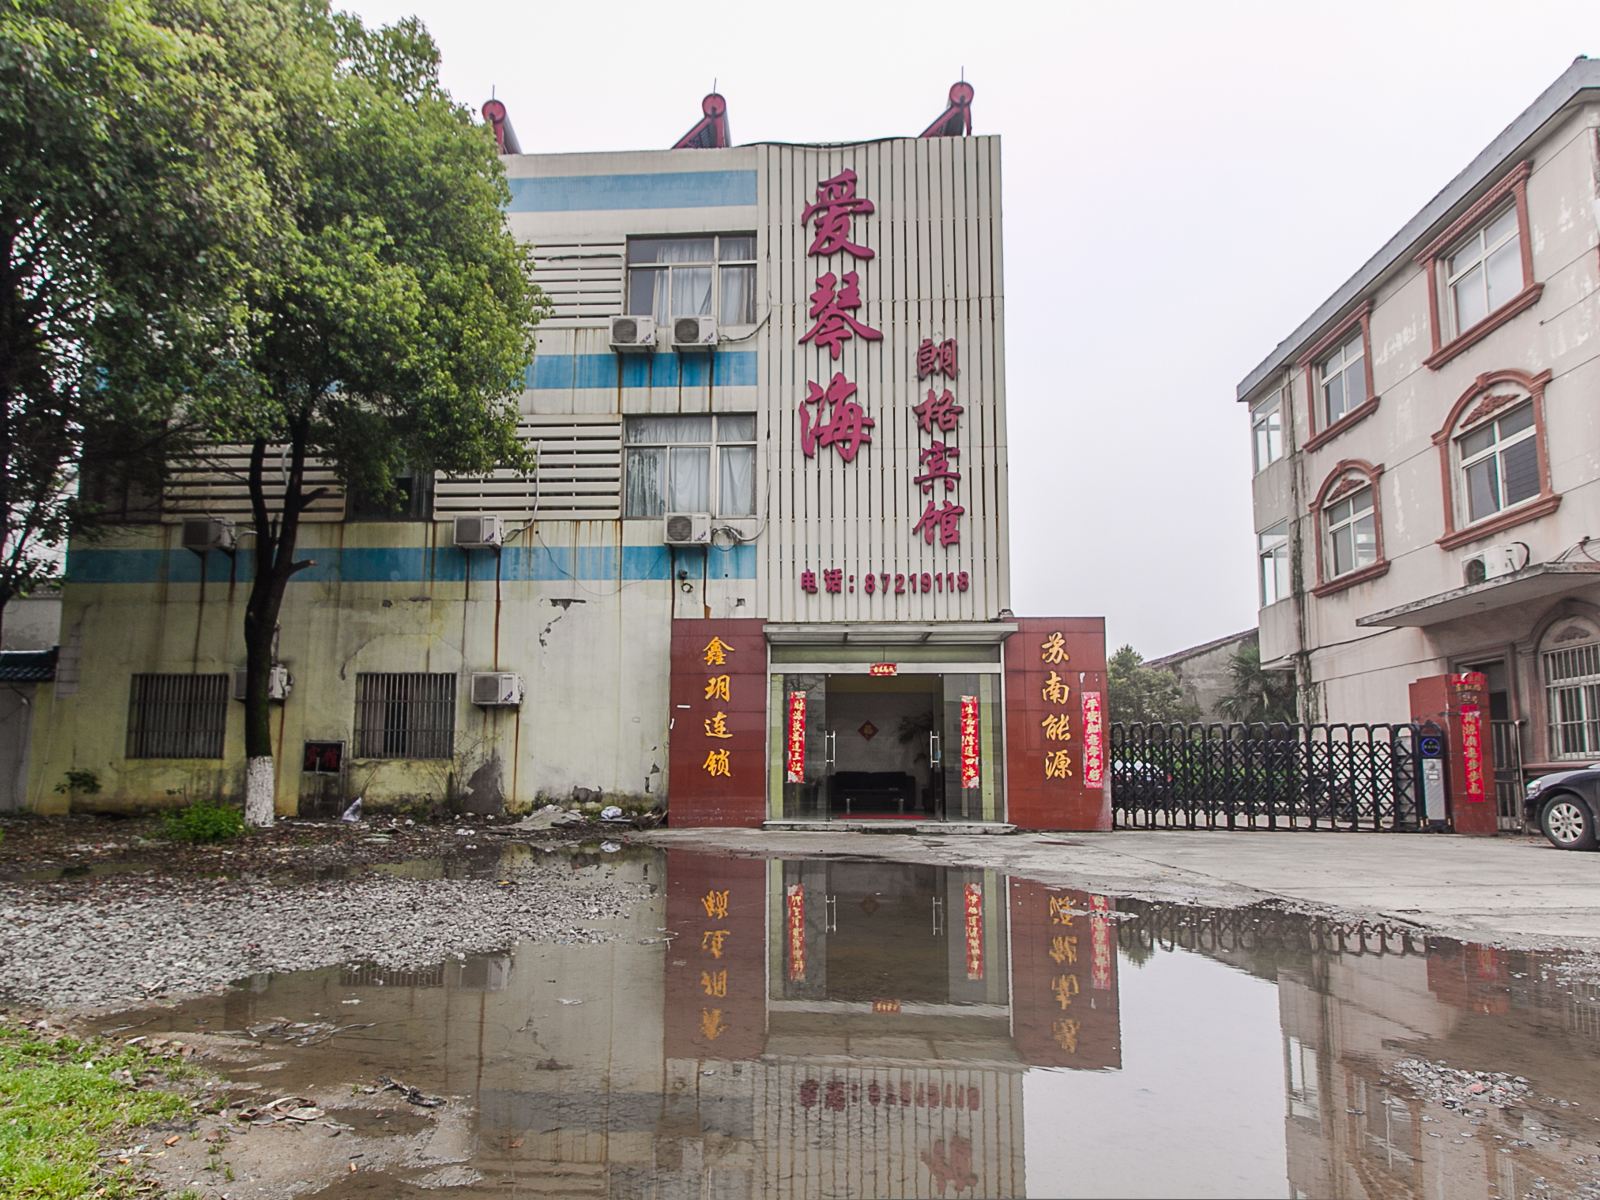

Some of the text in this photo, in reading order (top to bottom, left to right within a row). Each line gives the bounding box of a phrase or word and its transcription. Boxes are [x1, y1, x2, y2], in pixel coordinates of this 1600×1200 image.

[798, 168, 883, 463] 爱琴海
[912, 338, 965, 548] 朗格宾馆
[702, 636, 735, 778] 鑫玥连锁
[1041, 632, 1073, 780] 苏南能源
